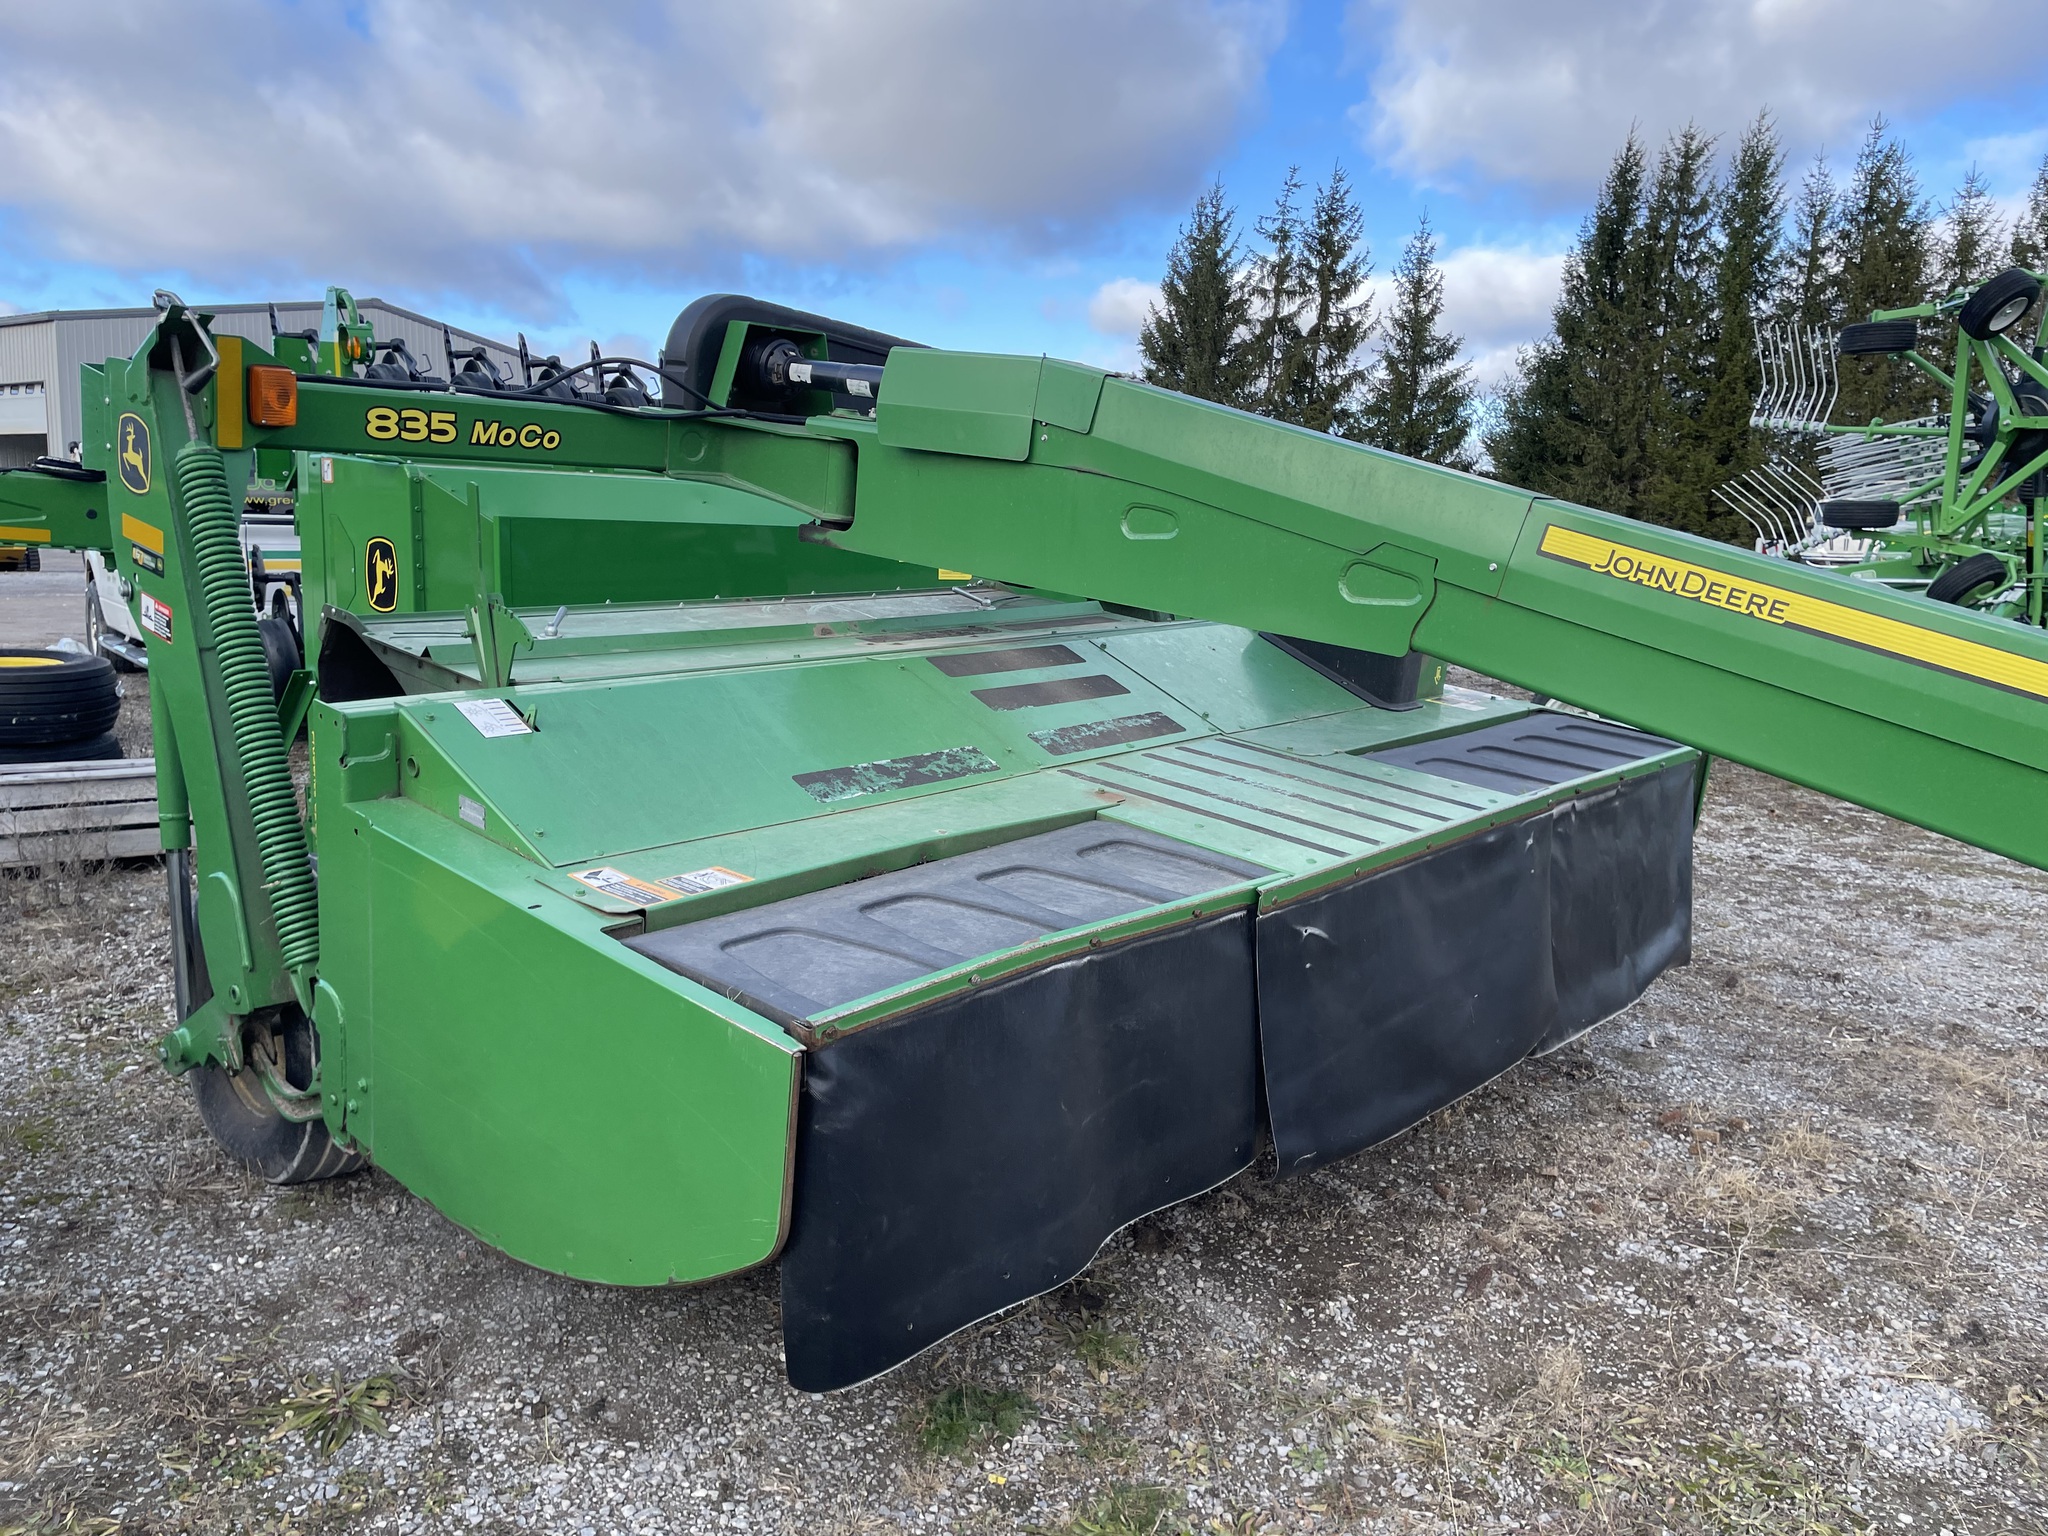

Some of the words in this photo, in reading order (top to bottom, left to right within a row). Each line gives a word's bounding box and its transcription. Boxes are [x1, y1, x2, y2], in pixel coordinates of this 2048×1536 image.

[366, 407, 458, 444] 835
[470, 419, 562, 450] MoCo
[1594, 549, 1679, 590] JOHN
[1680, 570, 1790, 621] DEERE
